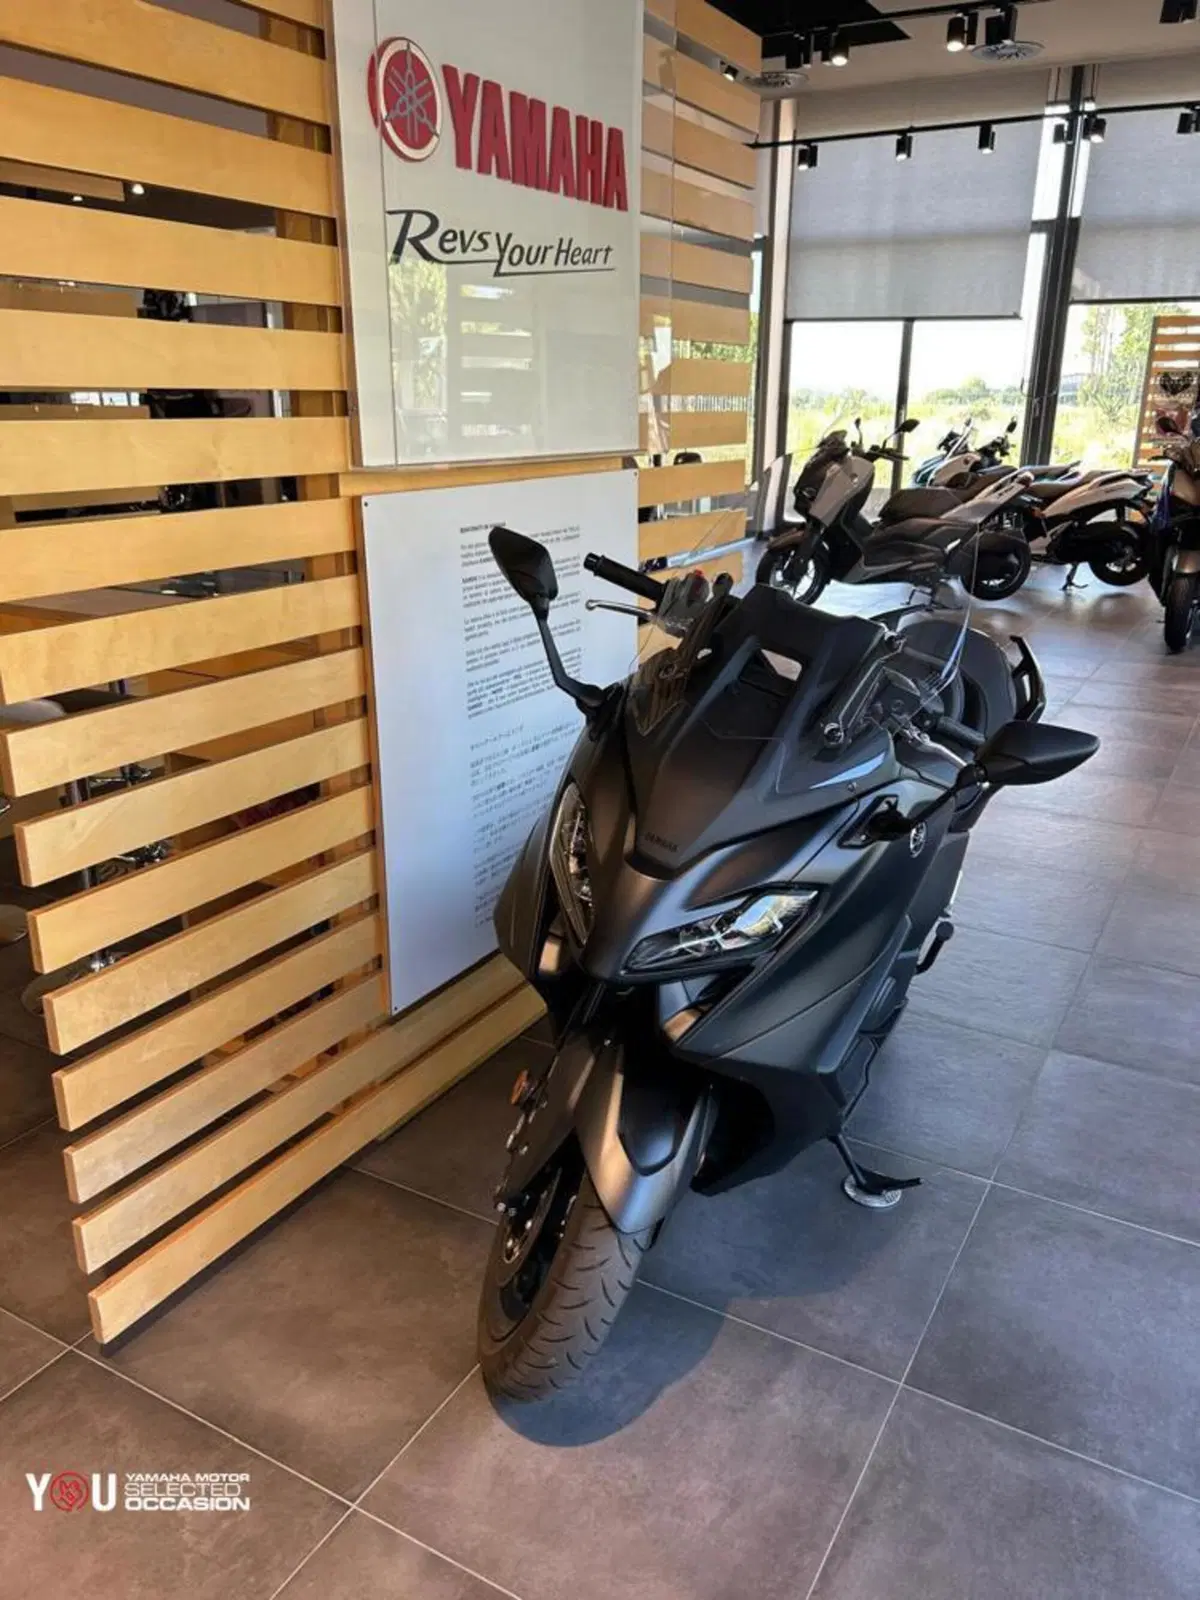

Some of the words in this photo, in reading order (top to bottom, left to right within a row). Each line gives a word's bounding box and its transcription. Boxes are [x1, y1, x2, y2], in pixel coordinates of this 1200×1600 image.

[441, 63, 629, 212] YAMAHA
[385, 208, 492, 264] Revs
[494, 231, 553, 277] Your
[554, 237, 614, 266] Heart
